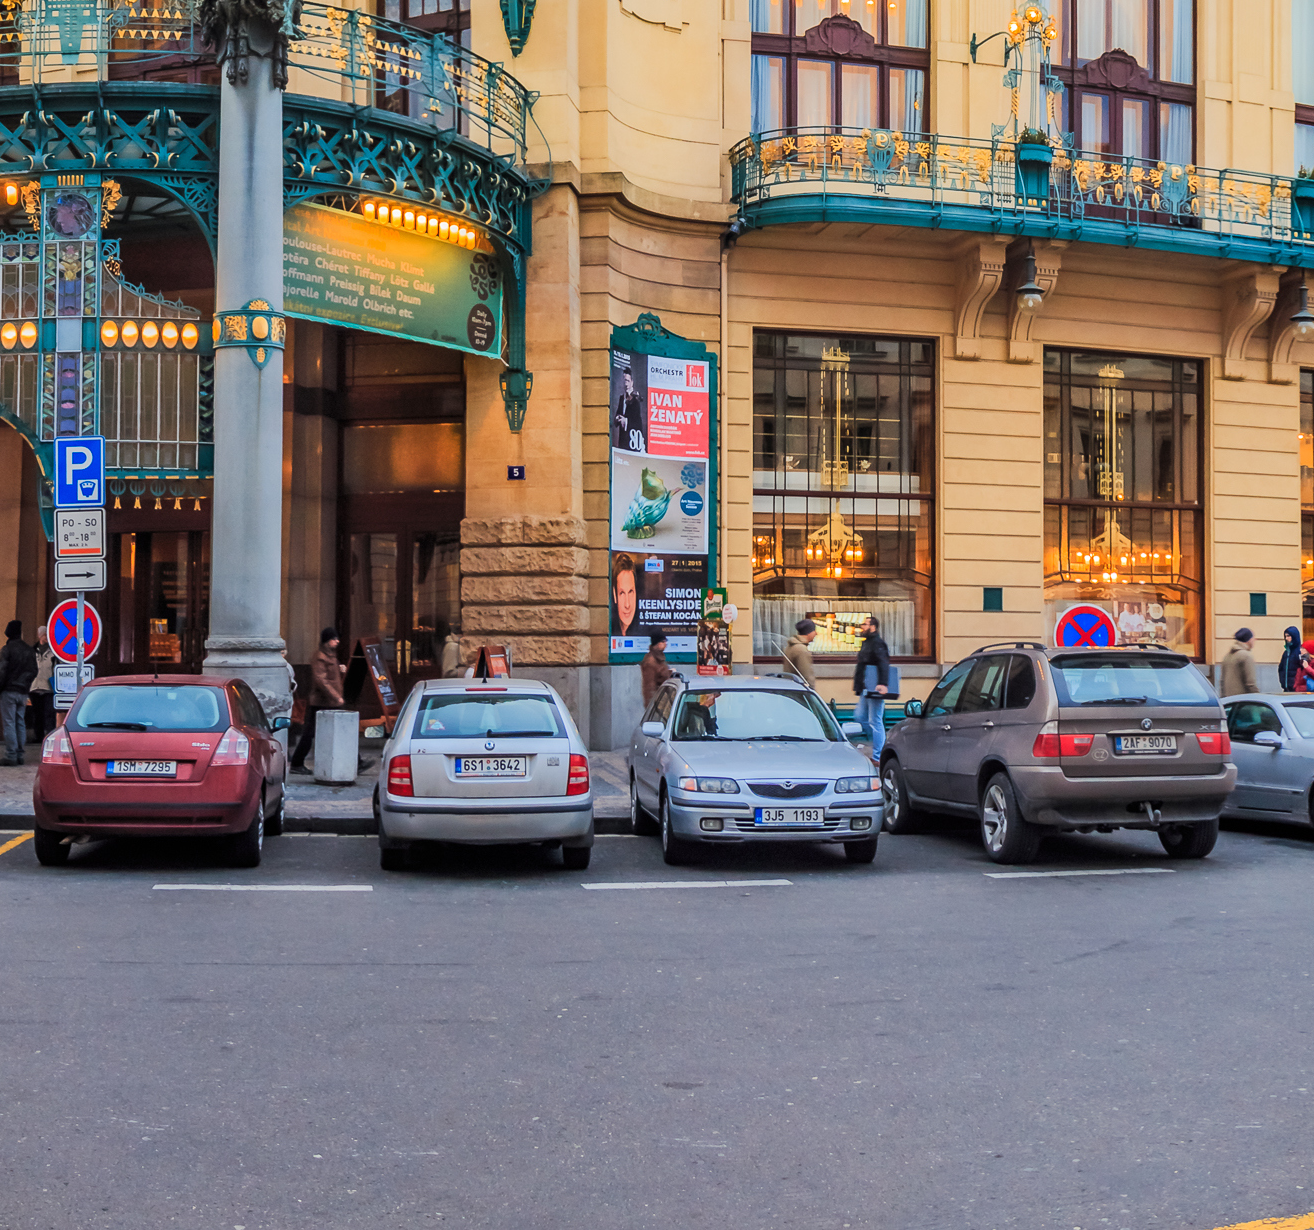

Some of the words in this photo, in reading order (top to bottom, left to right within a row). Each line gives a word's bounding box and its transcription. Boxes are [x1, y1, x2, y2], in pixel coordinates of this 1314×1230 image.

[283, 236, 362, 262] oulouse-Lautrec
[367, 253, 395, 270] Mucha
[400, 261, 424, 277] Klimt
[283, 252, 309, 265] otěra
[354, 265, 386, 284] Tiffany
[283, 268, 324, 284] offmann
[330, 275, 365, 296] Preissig
[396, 290, 421, 305] Daum
[283, 283, 319, 299] ajorelle
[325, 290, 358, 307] Marold
[363, 298, 397, 317] Olbrich
[651, 367, 683, 376] ORCHESTR
[688, 365, 702, 387] fok
[651, 393, 682, 408] IVAN
[650, 406, 703, 425] ŽENATÝ
[66, 446, 93, 485] P
[513, 468, 519, 476] 5
[62, 519, 74, 527] PO
[85, 518, 97, 527] SO
[666, 588, 701, 598] SIMON
[639, 599, 701, 610] KEENLYSIDE
[645, 611, 672, 620] ŠTEFAN
[673, 611, 702, 620] KOCÁN
[1123, 737, 1140, 748] 2AF
[1148, 736, 1172, 748] 9070
[117, 762, 136, 772] 1SM
[144, 762, 171, 772] 7295
[464, 760, 483, 770] 6S1
[493, 760, 520, 770] 3642
[765, 810, 784, 821] 3J5
[793, 810, 818, 821] 1193
